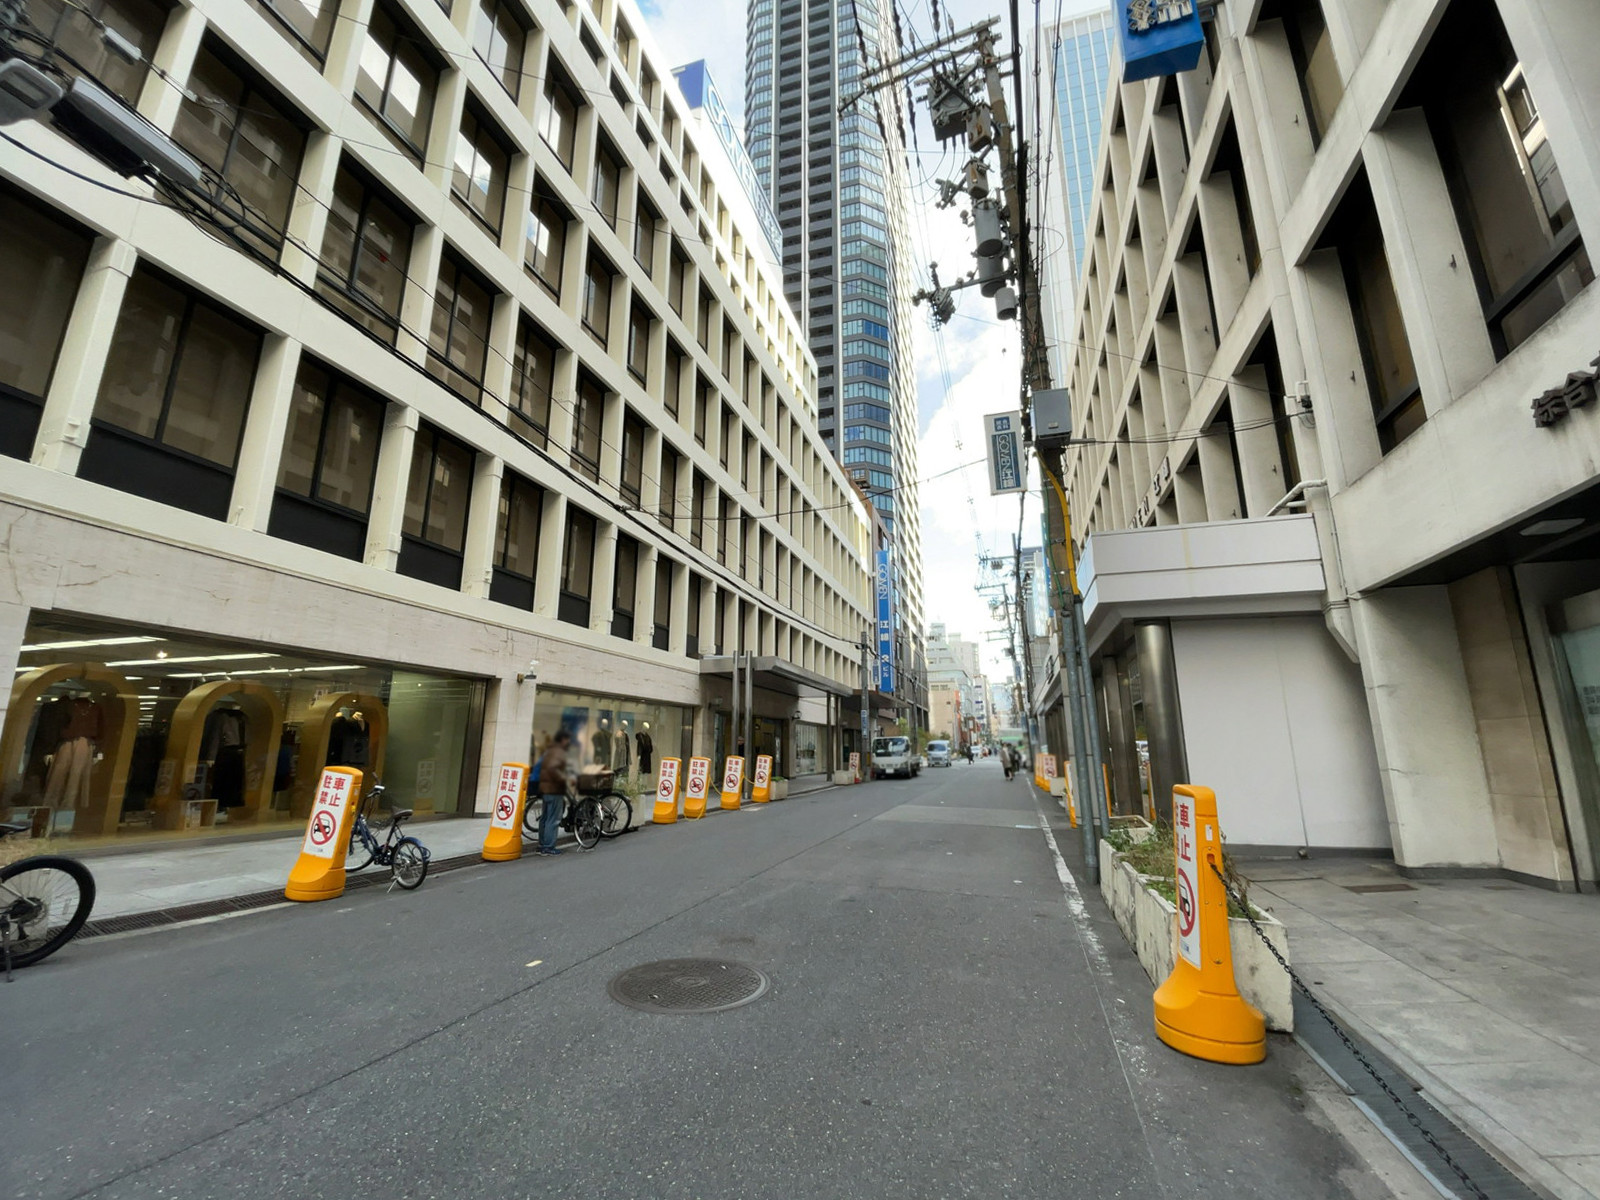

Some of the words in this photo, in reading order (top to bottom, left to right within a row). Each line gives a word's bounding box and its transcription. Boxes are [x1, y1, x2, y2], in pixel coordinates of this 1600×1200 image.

[502, 768, 518, 780] 駐車
[323, 774, 346, 791] 駐車
[500, 780, 516, 792] 禁止
[318, 790, 342, 807] 禁止
